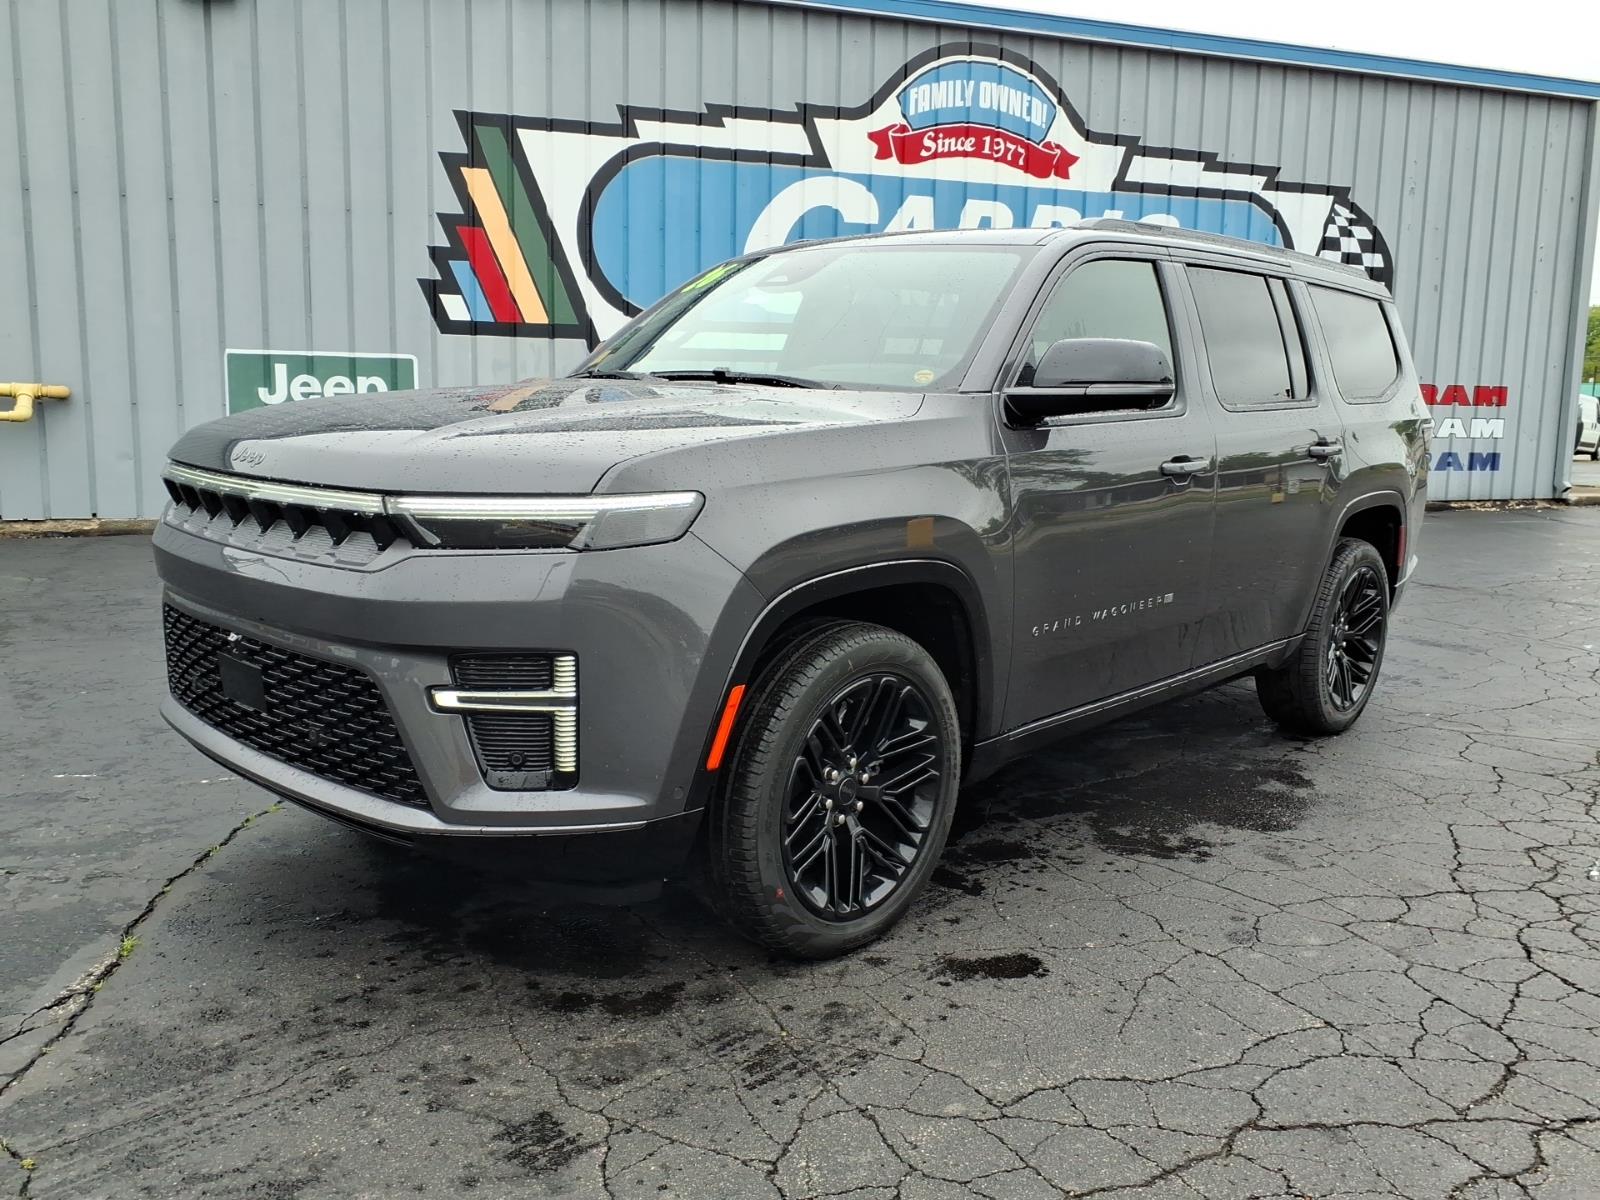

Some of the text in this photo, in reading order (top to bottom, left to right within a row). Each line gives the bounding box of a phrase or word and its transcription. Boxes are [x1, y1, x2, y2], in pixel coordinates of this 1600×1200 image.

[909, 80, 1048, 129] FAMILY OWNED!
[920, 131, 1027, 166] Since 1977
[1432, 417, 1505, 439] AM
[231, 446, 266, 469] Jeep
[1427, 452, 1501, 471] AM
[1032, 615, 1082, 637] GRAND
